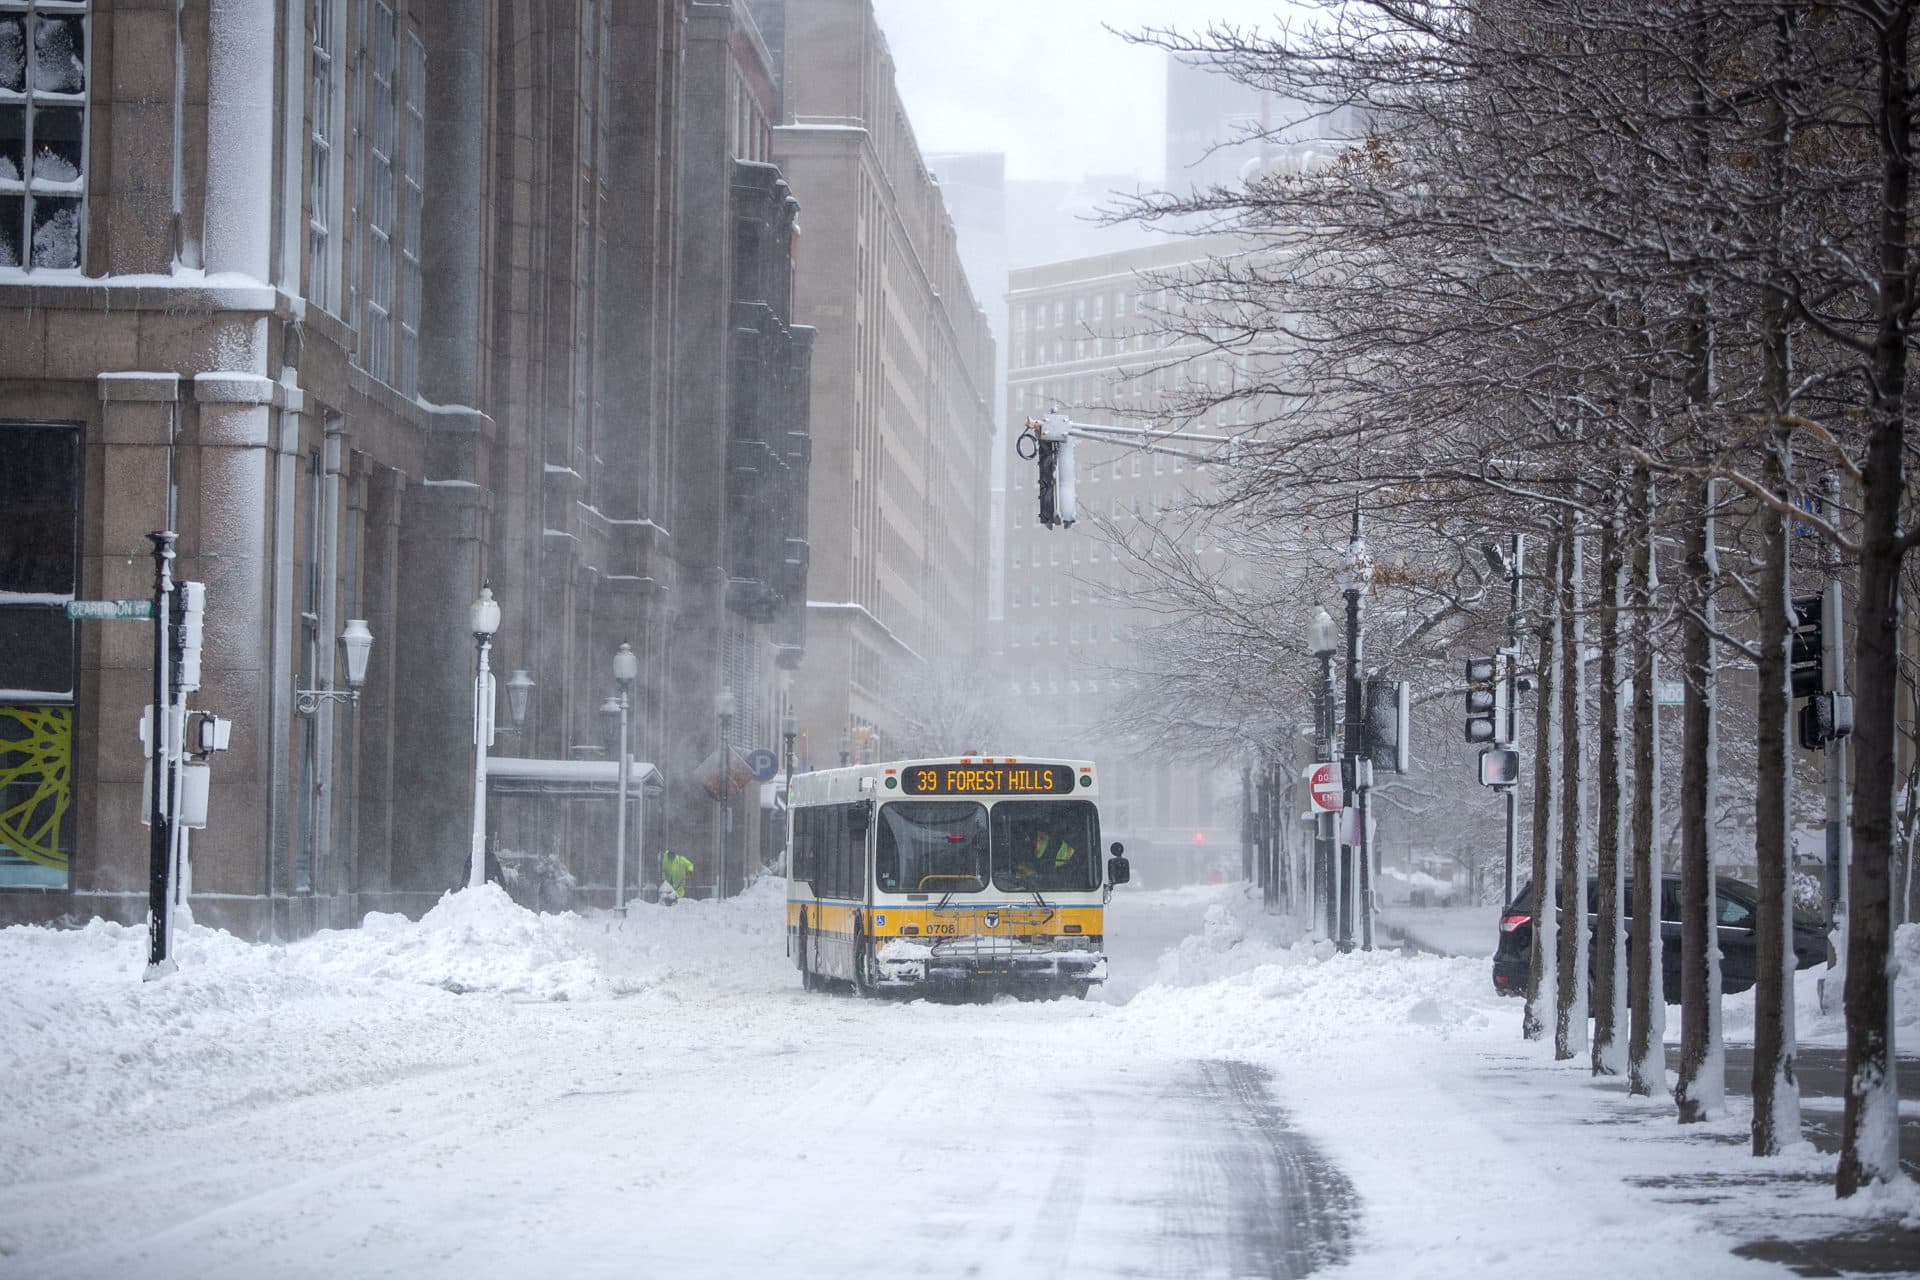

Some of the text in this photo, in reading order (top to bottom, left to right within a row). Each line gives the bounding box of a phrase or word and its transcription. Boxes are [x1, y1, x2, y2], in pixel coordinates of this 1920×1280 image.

[754, 755, 771, 777] P
[917, 770, 1053, 791] 39 FOREST HILLS
[1318, 774, 1329, 782] DO
[926, 924, 955, 934] 0708
